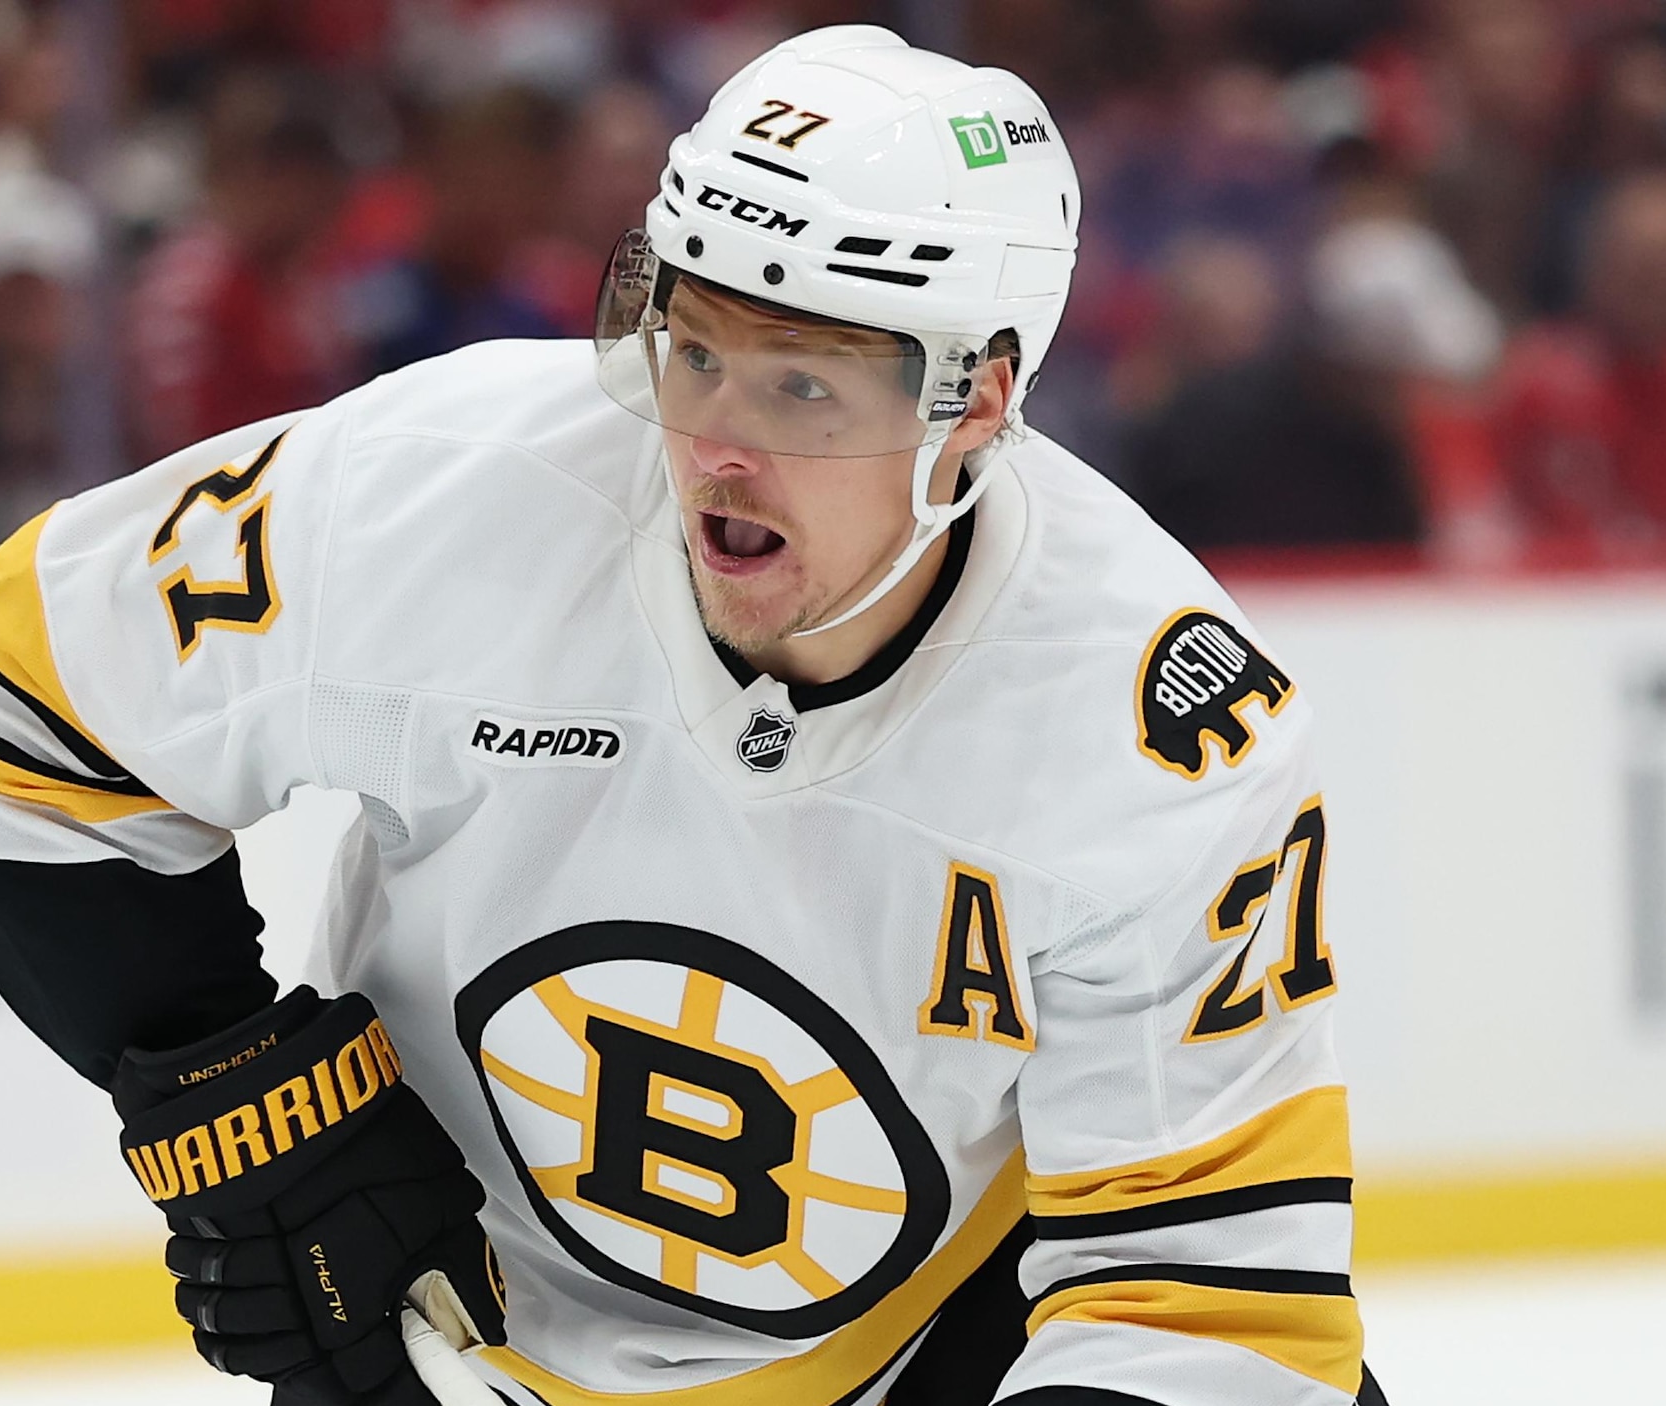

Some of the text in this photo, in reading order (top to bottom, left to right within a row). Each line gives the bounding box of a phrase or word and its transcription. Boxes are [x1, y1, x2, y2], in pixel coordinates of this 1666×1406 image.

[740, 99, 833, 152] 27
[1002, 117, 1051, 147] Bank
[695, 184, 810, 238] CCM
[146, 418, 302, 666] 27
[1154, 621, 1248, 718] BOSTON
[471, 719, 621, 759] RAPID7
[744, 732, 788, 756] NHL
[1180, 791, 1338, 1046] 27
[917, 860, 1037, 1054] A
[178, 1032, 278, 1086] LINDHOLM
[126, 1016, 403, 1203] WARRIOR
[573, 1010, 801, 1262] B
